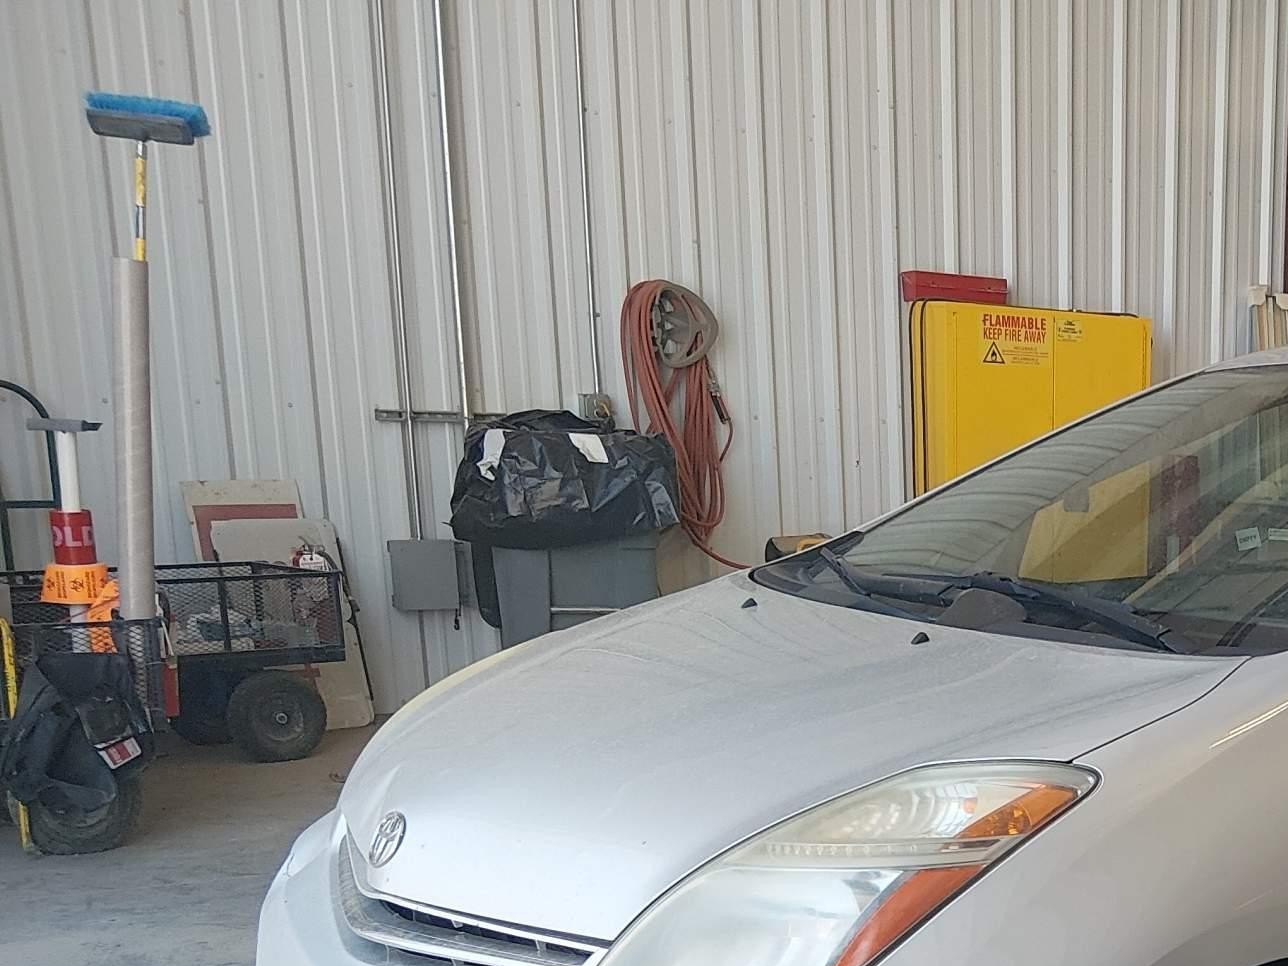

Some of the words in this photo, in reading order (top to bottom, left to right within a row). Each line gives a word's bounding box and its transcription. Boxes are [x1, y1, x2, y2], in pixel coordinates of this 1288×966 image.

[982, 313, 1047, 331] FLAMMABLE
[983, 327, 1002, 341] KEEP
[1004, 328, 1022, 343] FIRE
[1023, 330, 1047, 344] AWAY
